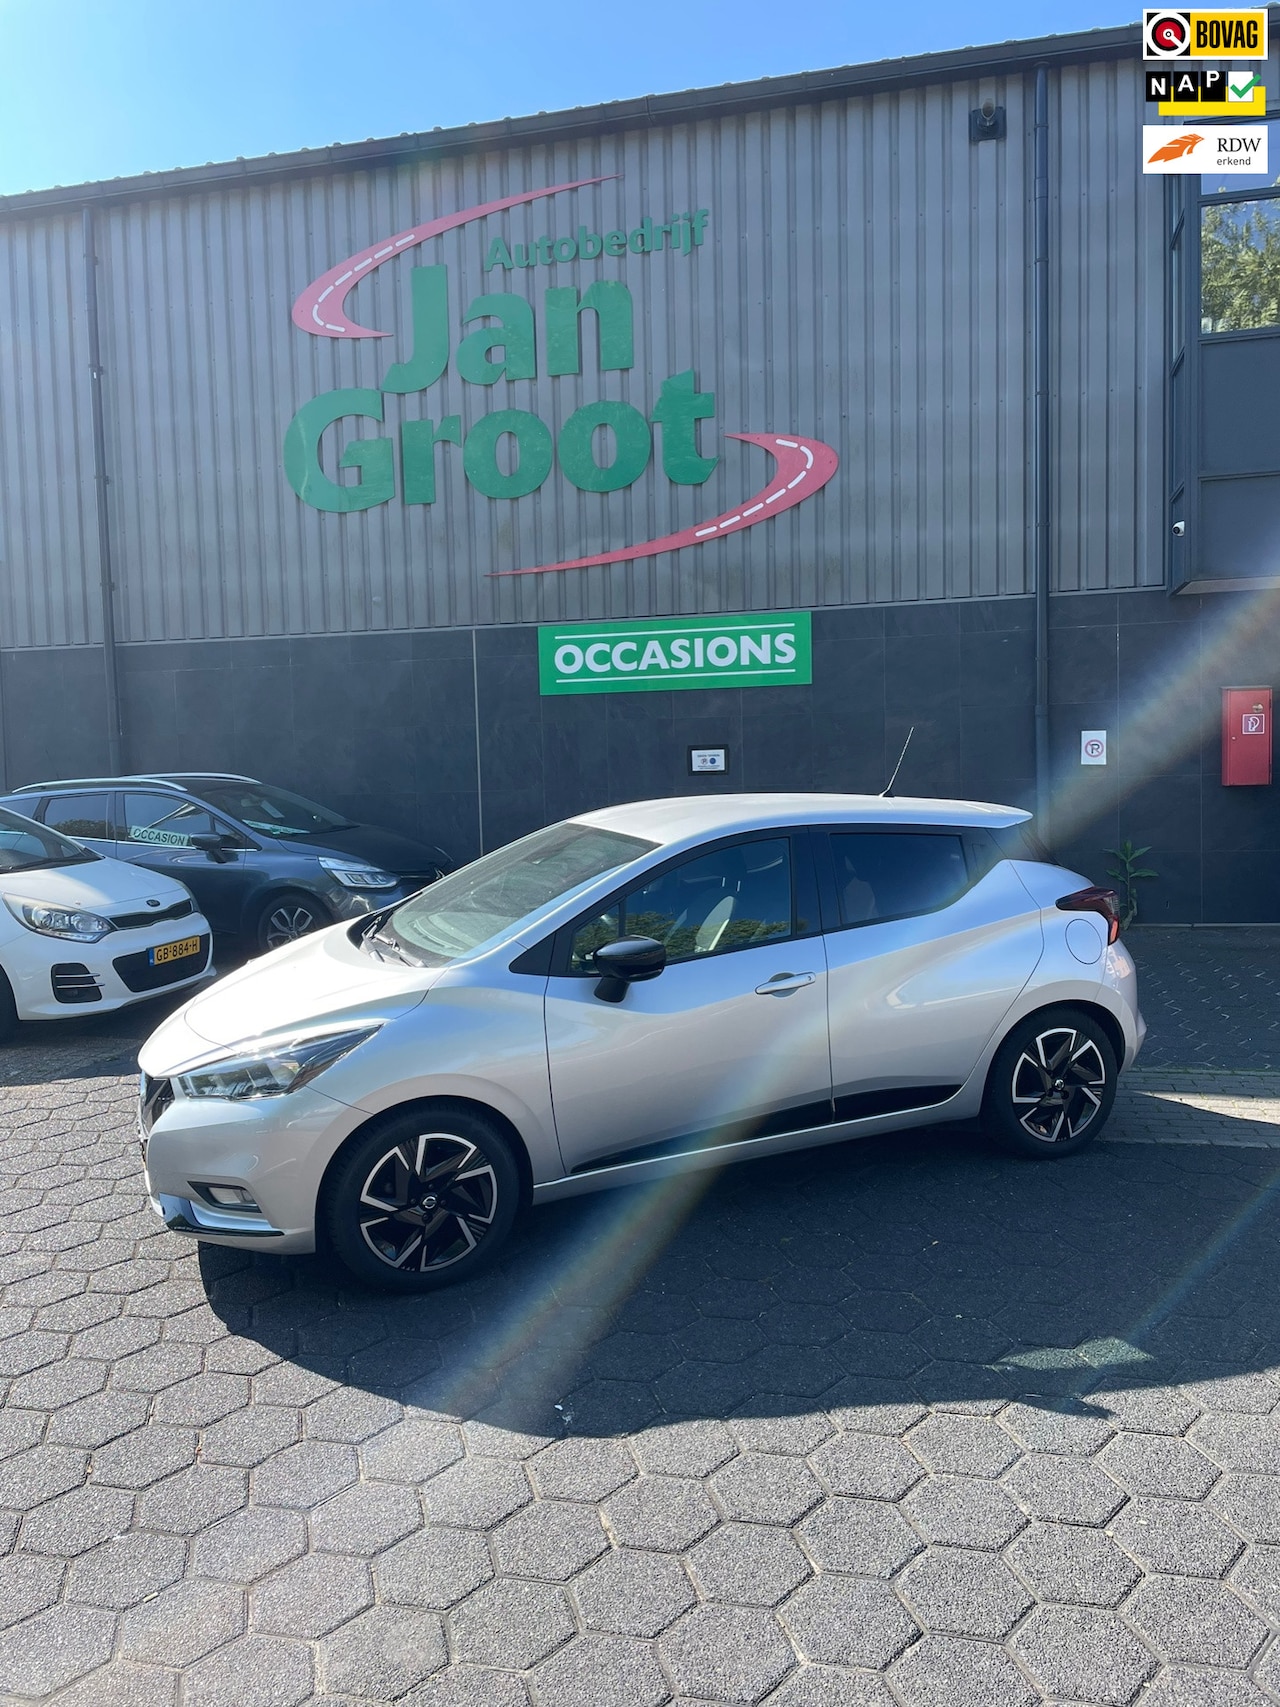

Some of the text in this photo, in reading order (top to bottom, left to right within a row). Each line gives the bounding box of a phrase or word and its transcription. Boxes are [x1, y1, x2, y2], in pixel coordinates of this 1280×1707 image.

[483, 208, 709, 272] Autobedrijf
[381, 264, 634, 394] Jan
[283, 368, 720, 513] Groot
[554, 632, 797, 675] OCCASIONS
[133, 828, 186, 845] OCCASION
